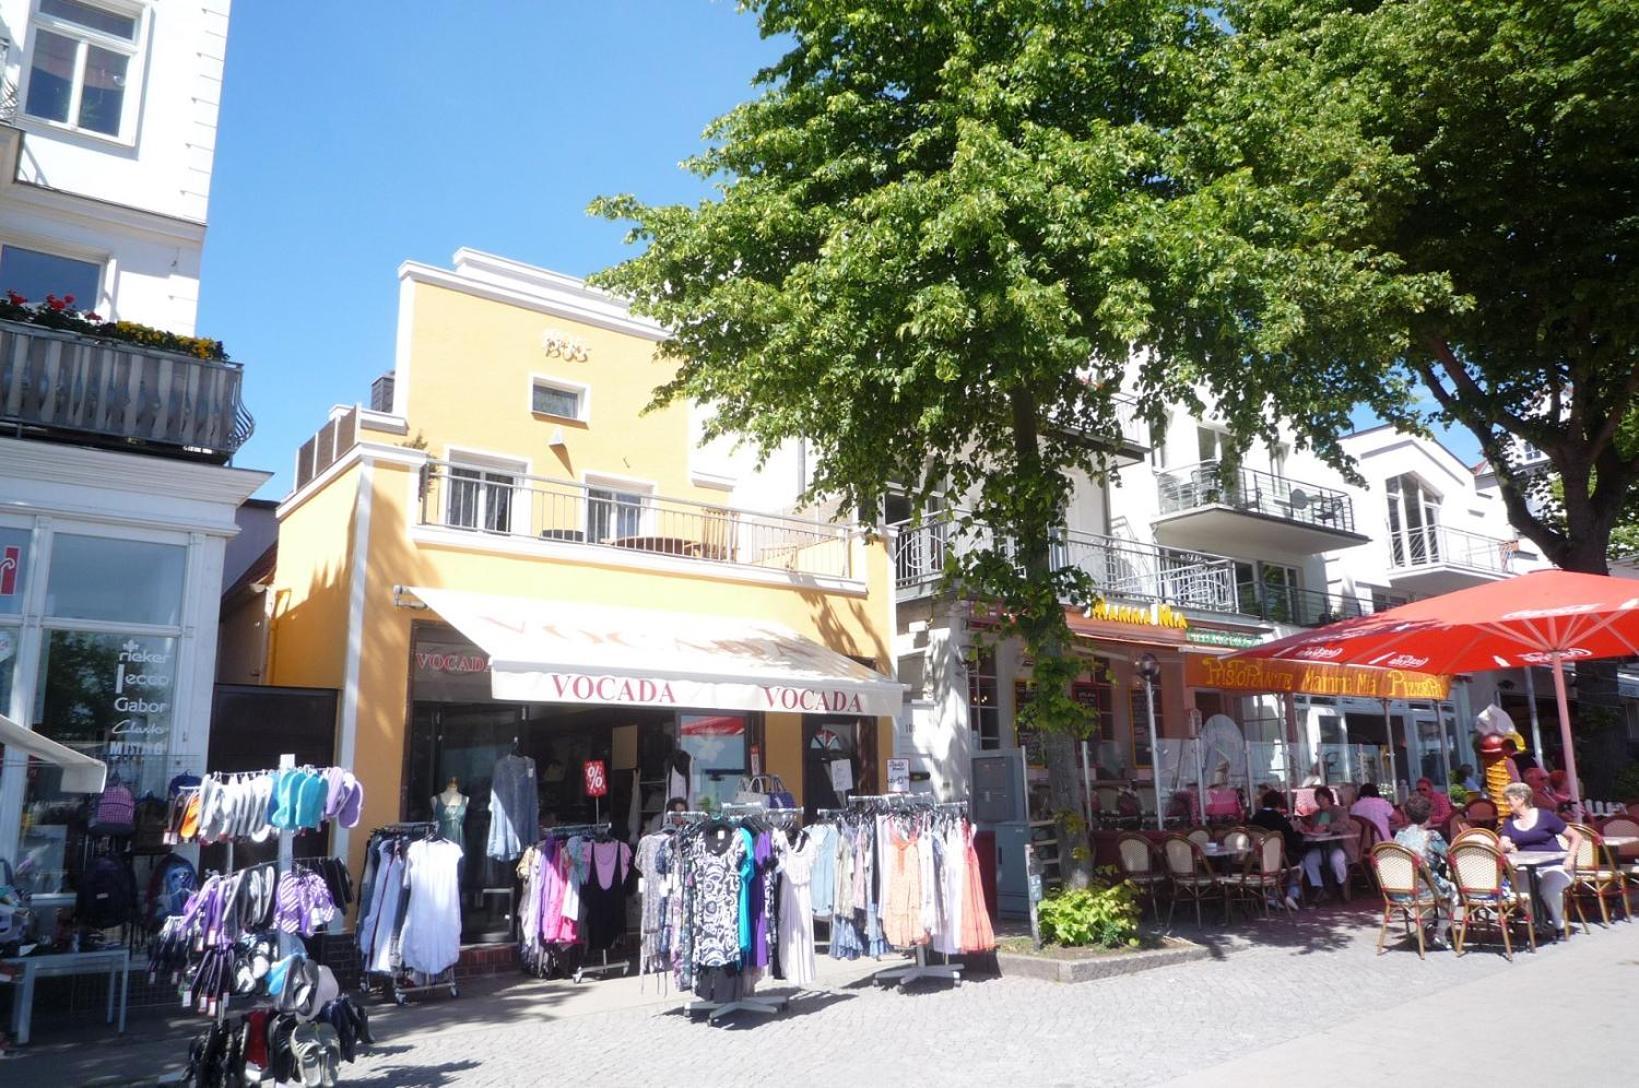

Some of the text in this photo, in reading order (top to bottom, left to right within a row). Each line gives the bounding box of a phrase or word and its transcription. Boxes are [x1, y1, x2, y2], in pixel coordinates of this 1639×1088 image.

[1159, 604, 1188, 629] MIA
[119, 646, 171, 664] rieker
[125, 673, 168, 686] ecco
[552, 675, 676, 704] VOCADA
[114, 697, 167, 713] Gabor
[762, 686, 863, 712] VOCADA
